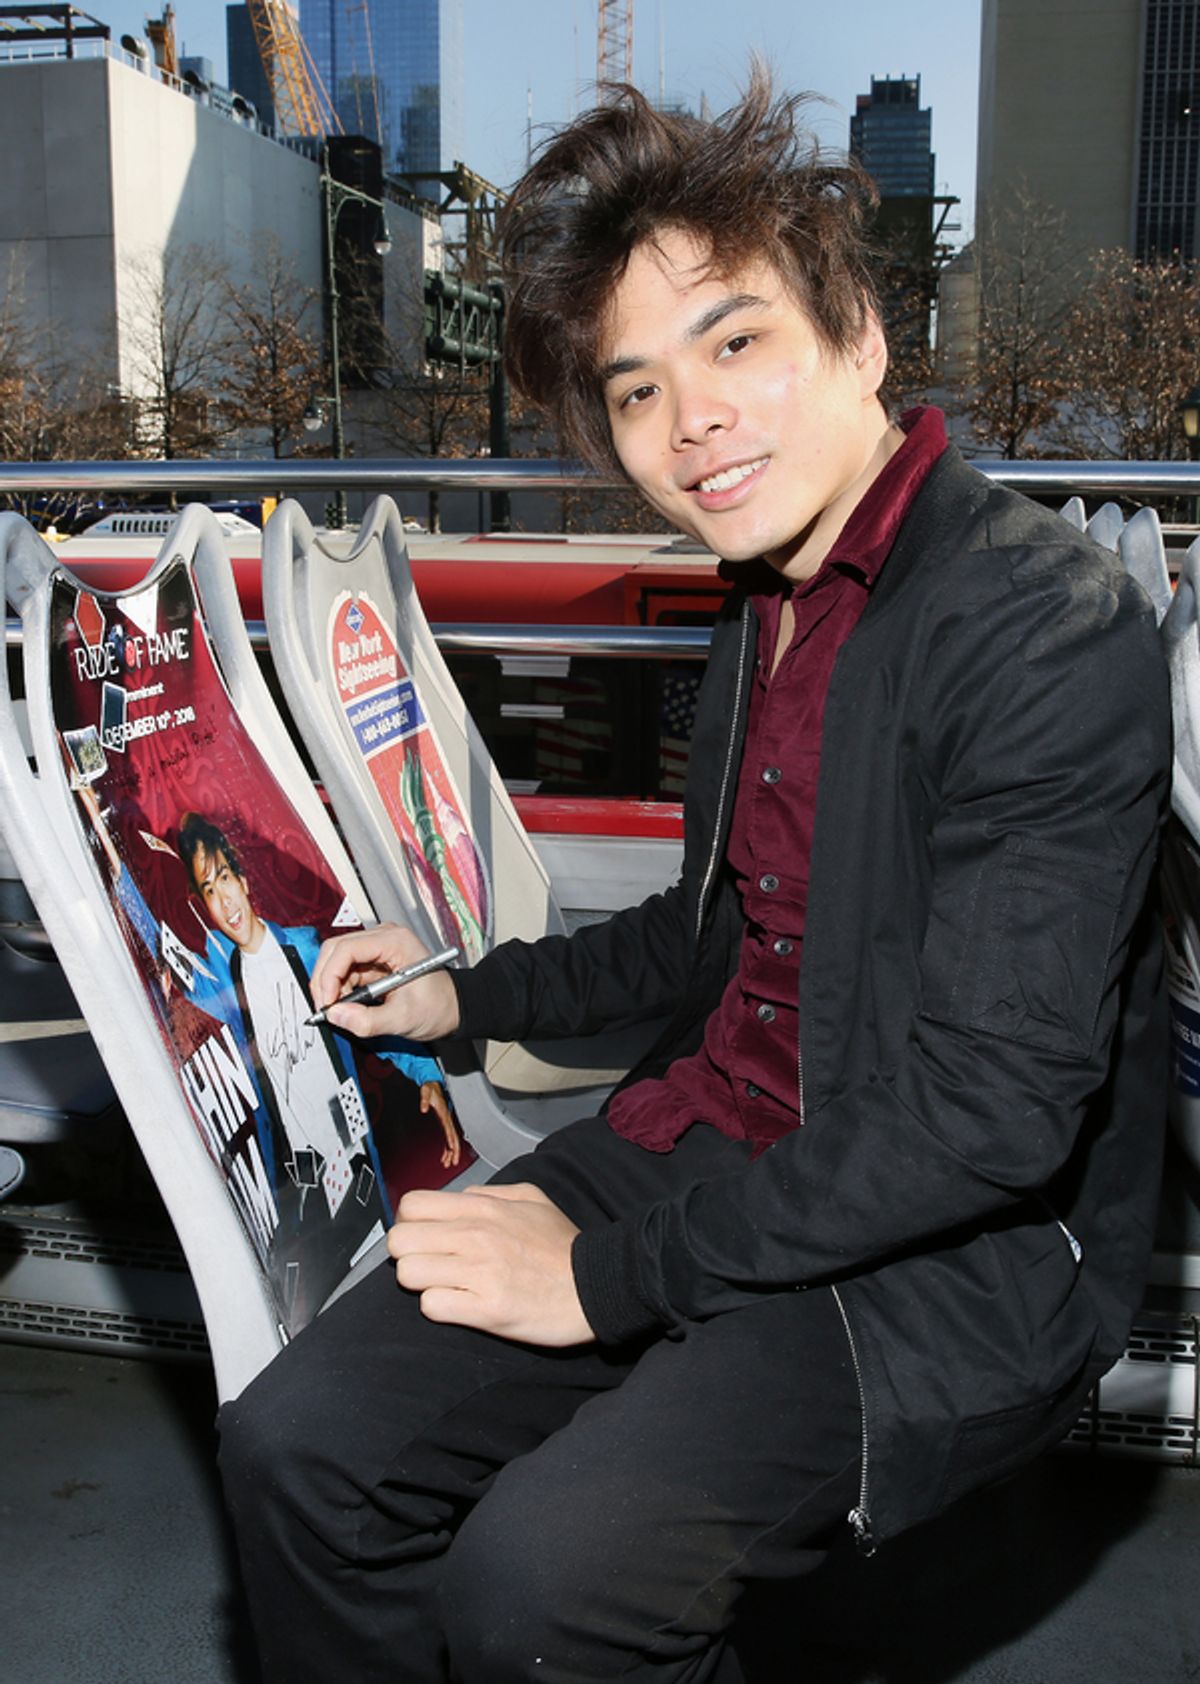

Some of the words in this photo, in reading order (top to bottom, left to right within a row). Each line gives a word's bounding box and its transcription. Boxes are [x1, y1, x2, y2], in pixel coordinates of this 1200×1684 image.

[74, 642, 120, 682] RIDE
[125, 636, 144, 669] OF
[146, 628, 190, 667] FAME
[104, 715, 157, 746] DECEMBER
